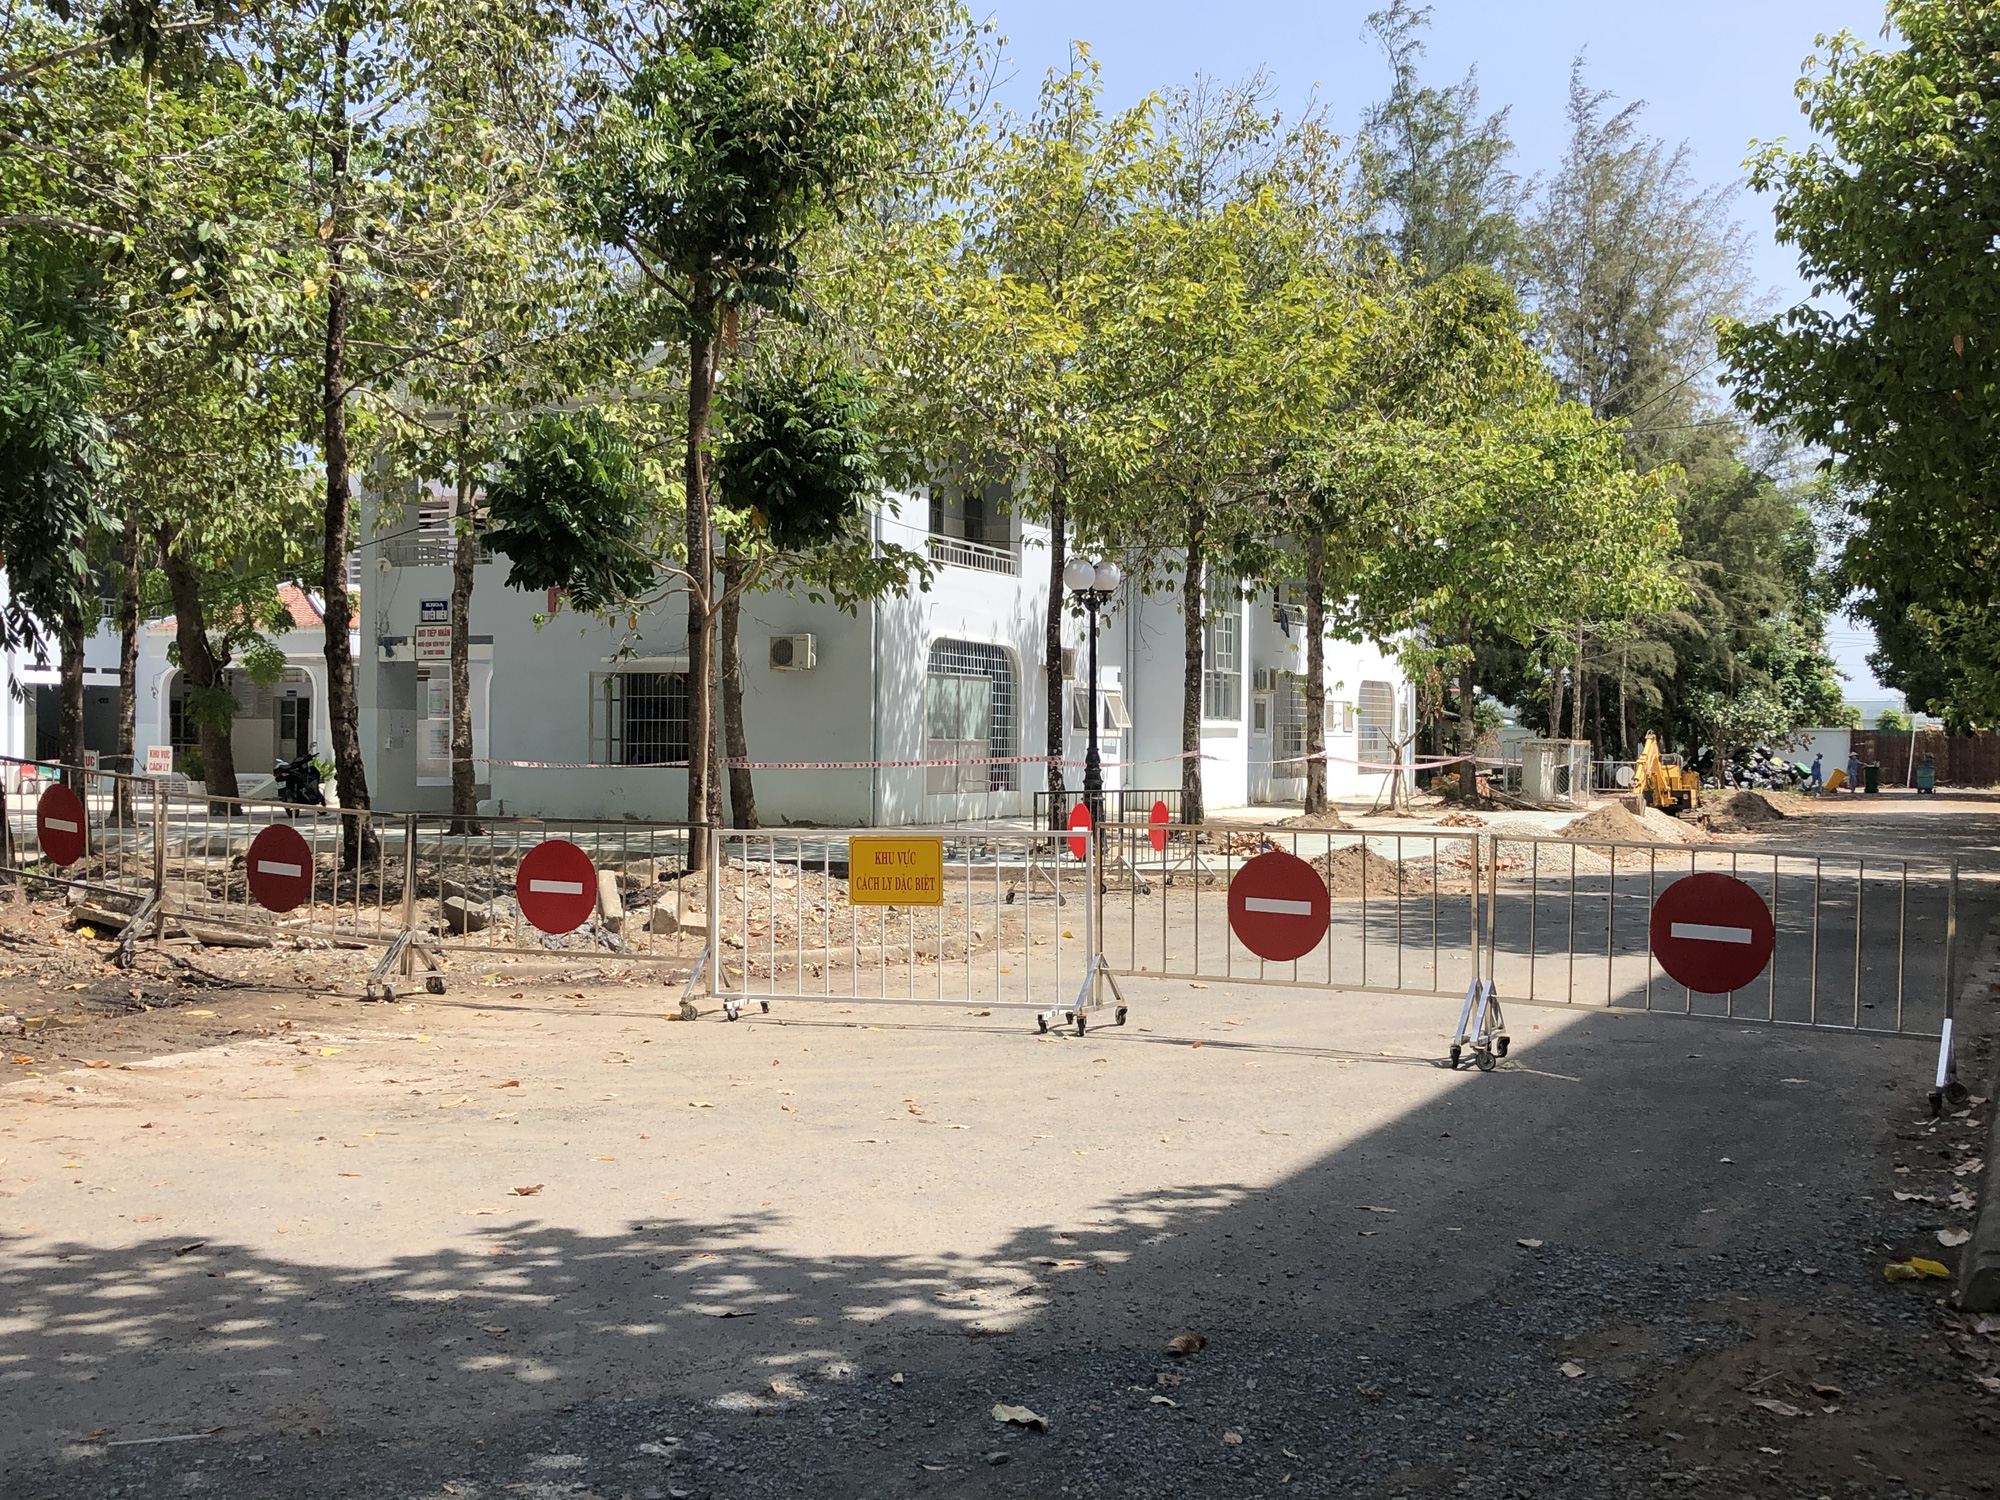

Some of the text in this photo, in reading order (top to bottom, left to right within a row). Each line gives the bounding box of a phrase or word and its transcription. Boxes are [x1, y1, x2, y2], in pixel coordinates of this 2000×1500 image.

[149, 750, 160, 758] KHU
[149, 760, 162, 771] CÁCH
[874, 849, 917, 868] KHU VỰC
[856, 873, 935, 894] CÁCH LY ĐẶC BIỆT
